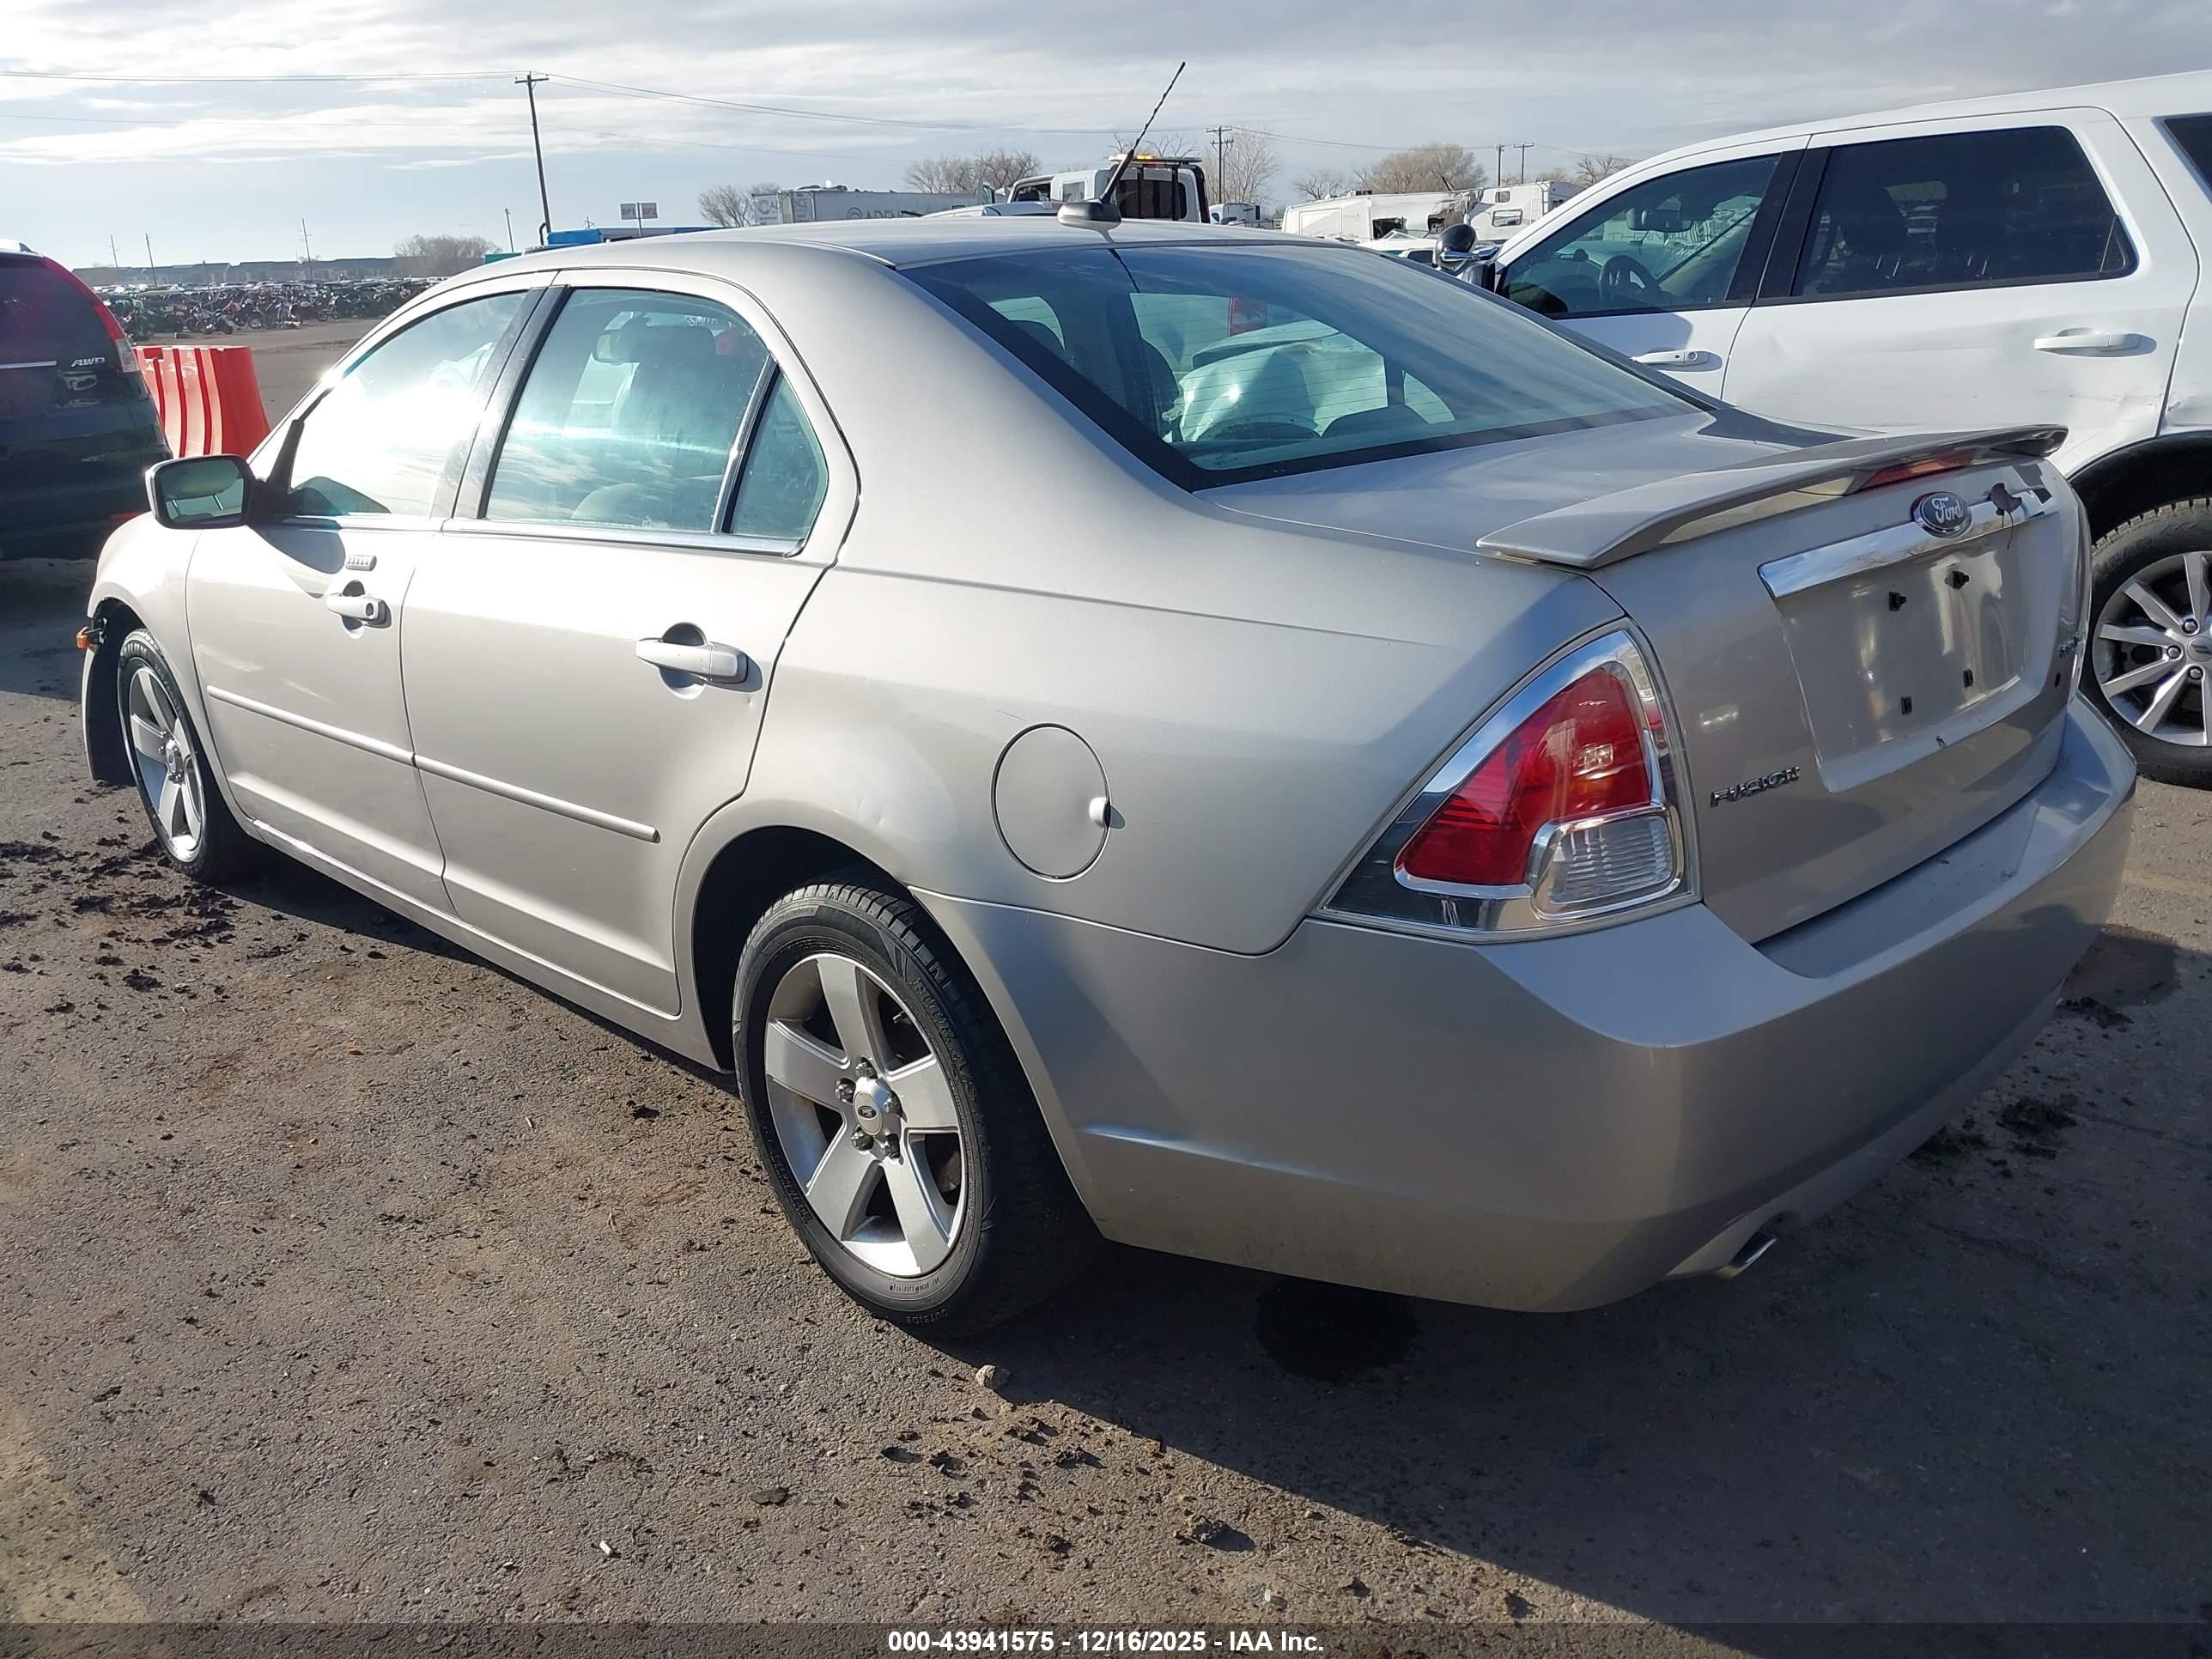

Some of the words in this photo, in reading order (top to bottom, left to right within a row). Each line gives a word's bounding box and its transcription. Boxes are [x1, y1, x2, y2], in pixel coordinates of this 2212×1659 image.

[70, 356, 106, 368] AWD
[1931, 496, 1964, 524] Ford
[1711, 766, 1800, 808] FUSION
